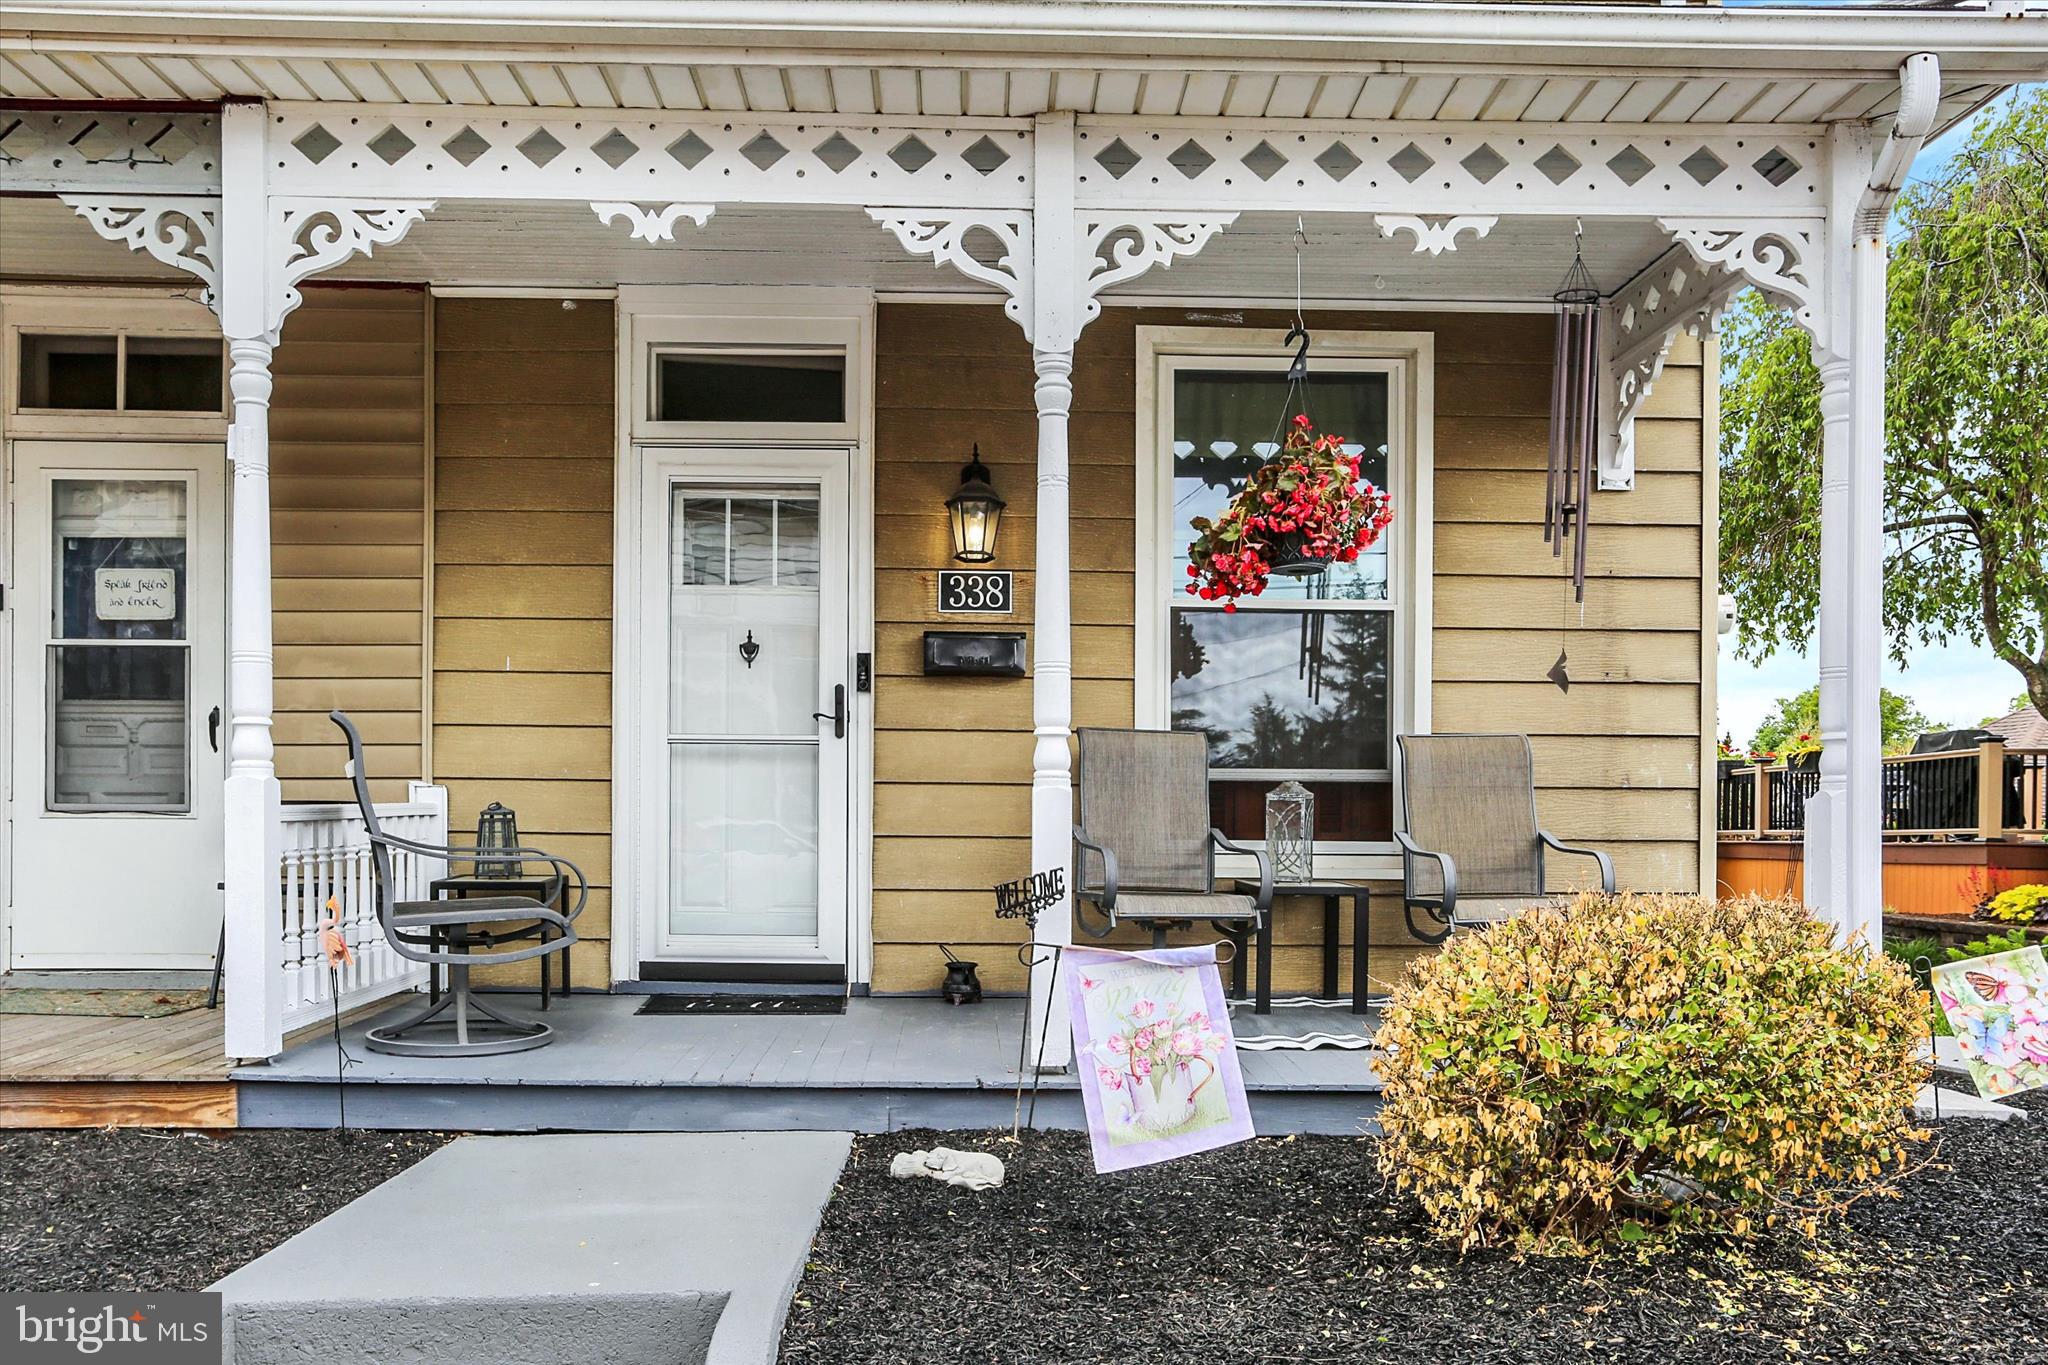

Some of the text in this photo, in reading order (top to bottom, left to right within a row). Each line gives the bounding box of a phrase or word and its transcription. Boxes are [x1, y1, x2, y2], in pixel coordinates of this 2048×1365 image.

[104, 578, 131, 591] Speak
[949, 575, 1004, 608] 338
[109, 597, 124, 607] and
[993, 867, 1065, 910] WELCOME
